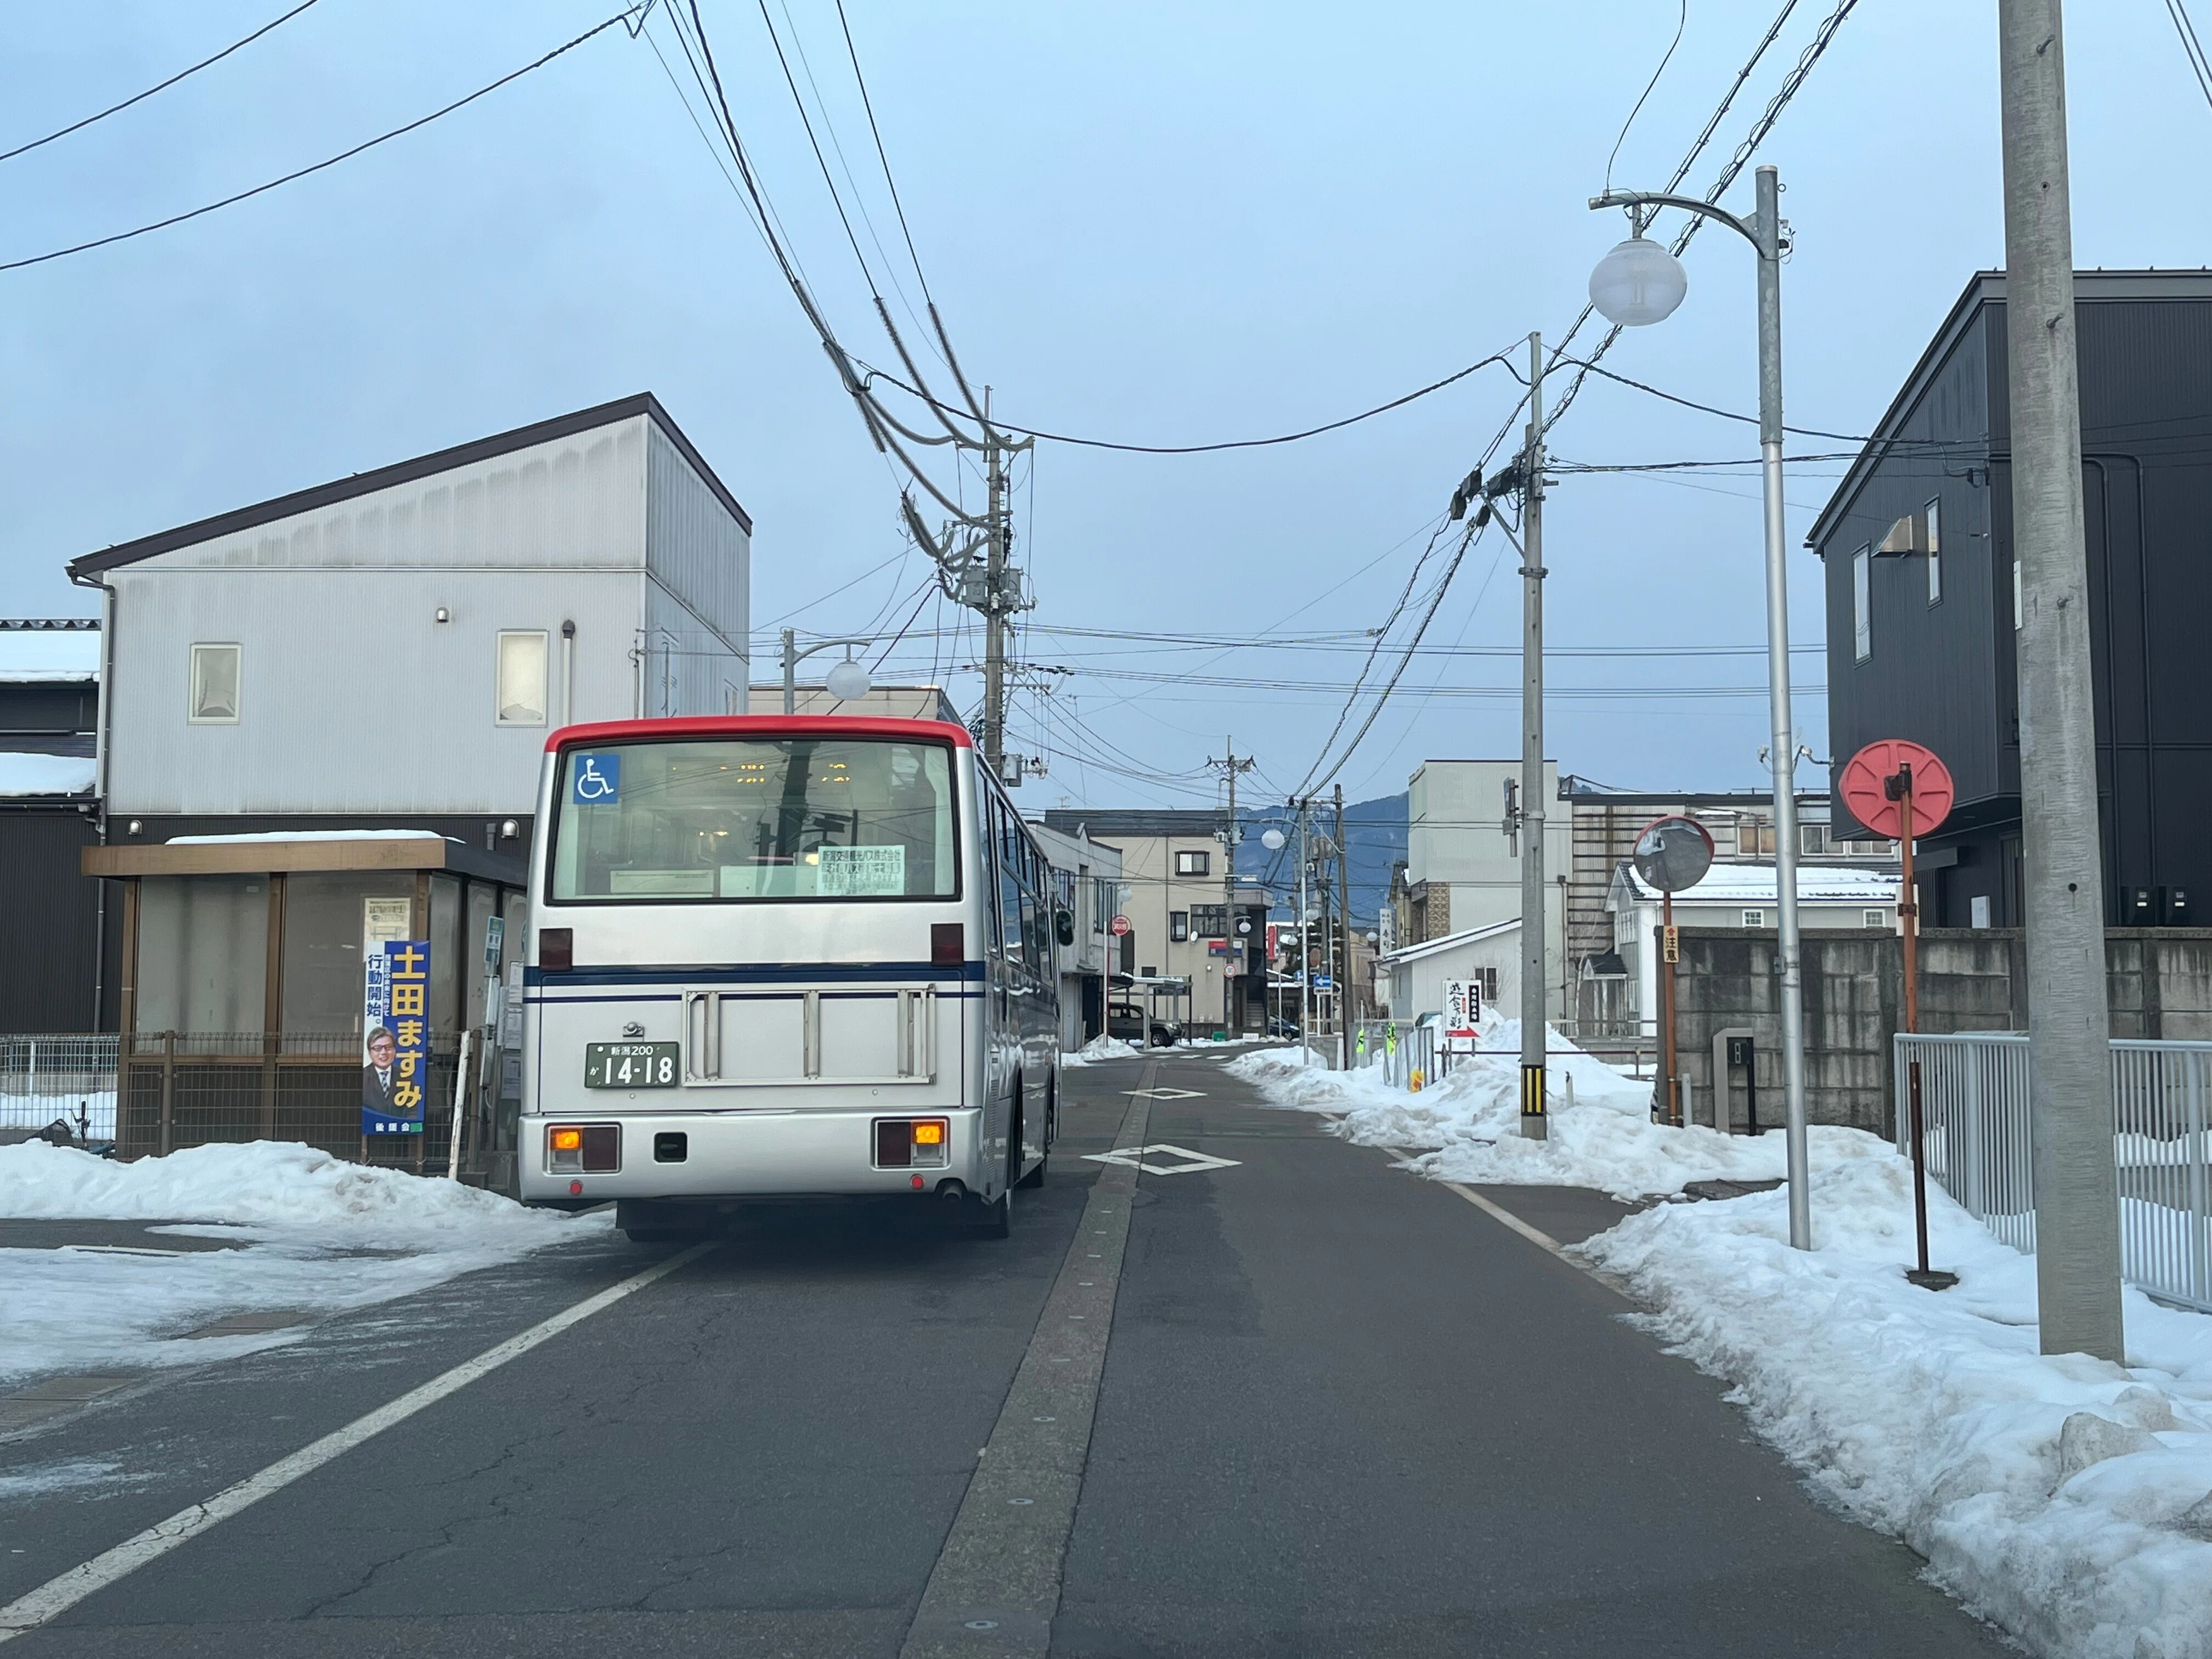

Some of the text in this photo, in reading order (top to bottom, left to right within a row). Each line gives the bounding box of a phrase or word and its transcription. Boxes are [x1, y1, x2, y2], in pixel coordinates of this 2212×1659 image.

[1665, 936, 1677, 961] 注意
[391, 945, 426, 1109] 土田ますみ
[605, 1057, 673, 1084] 14-18
